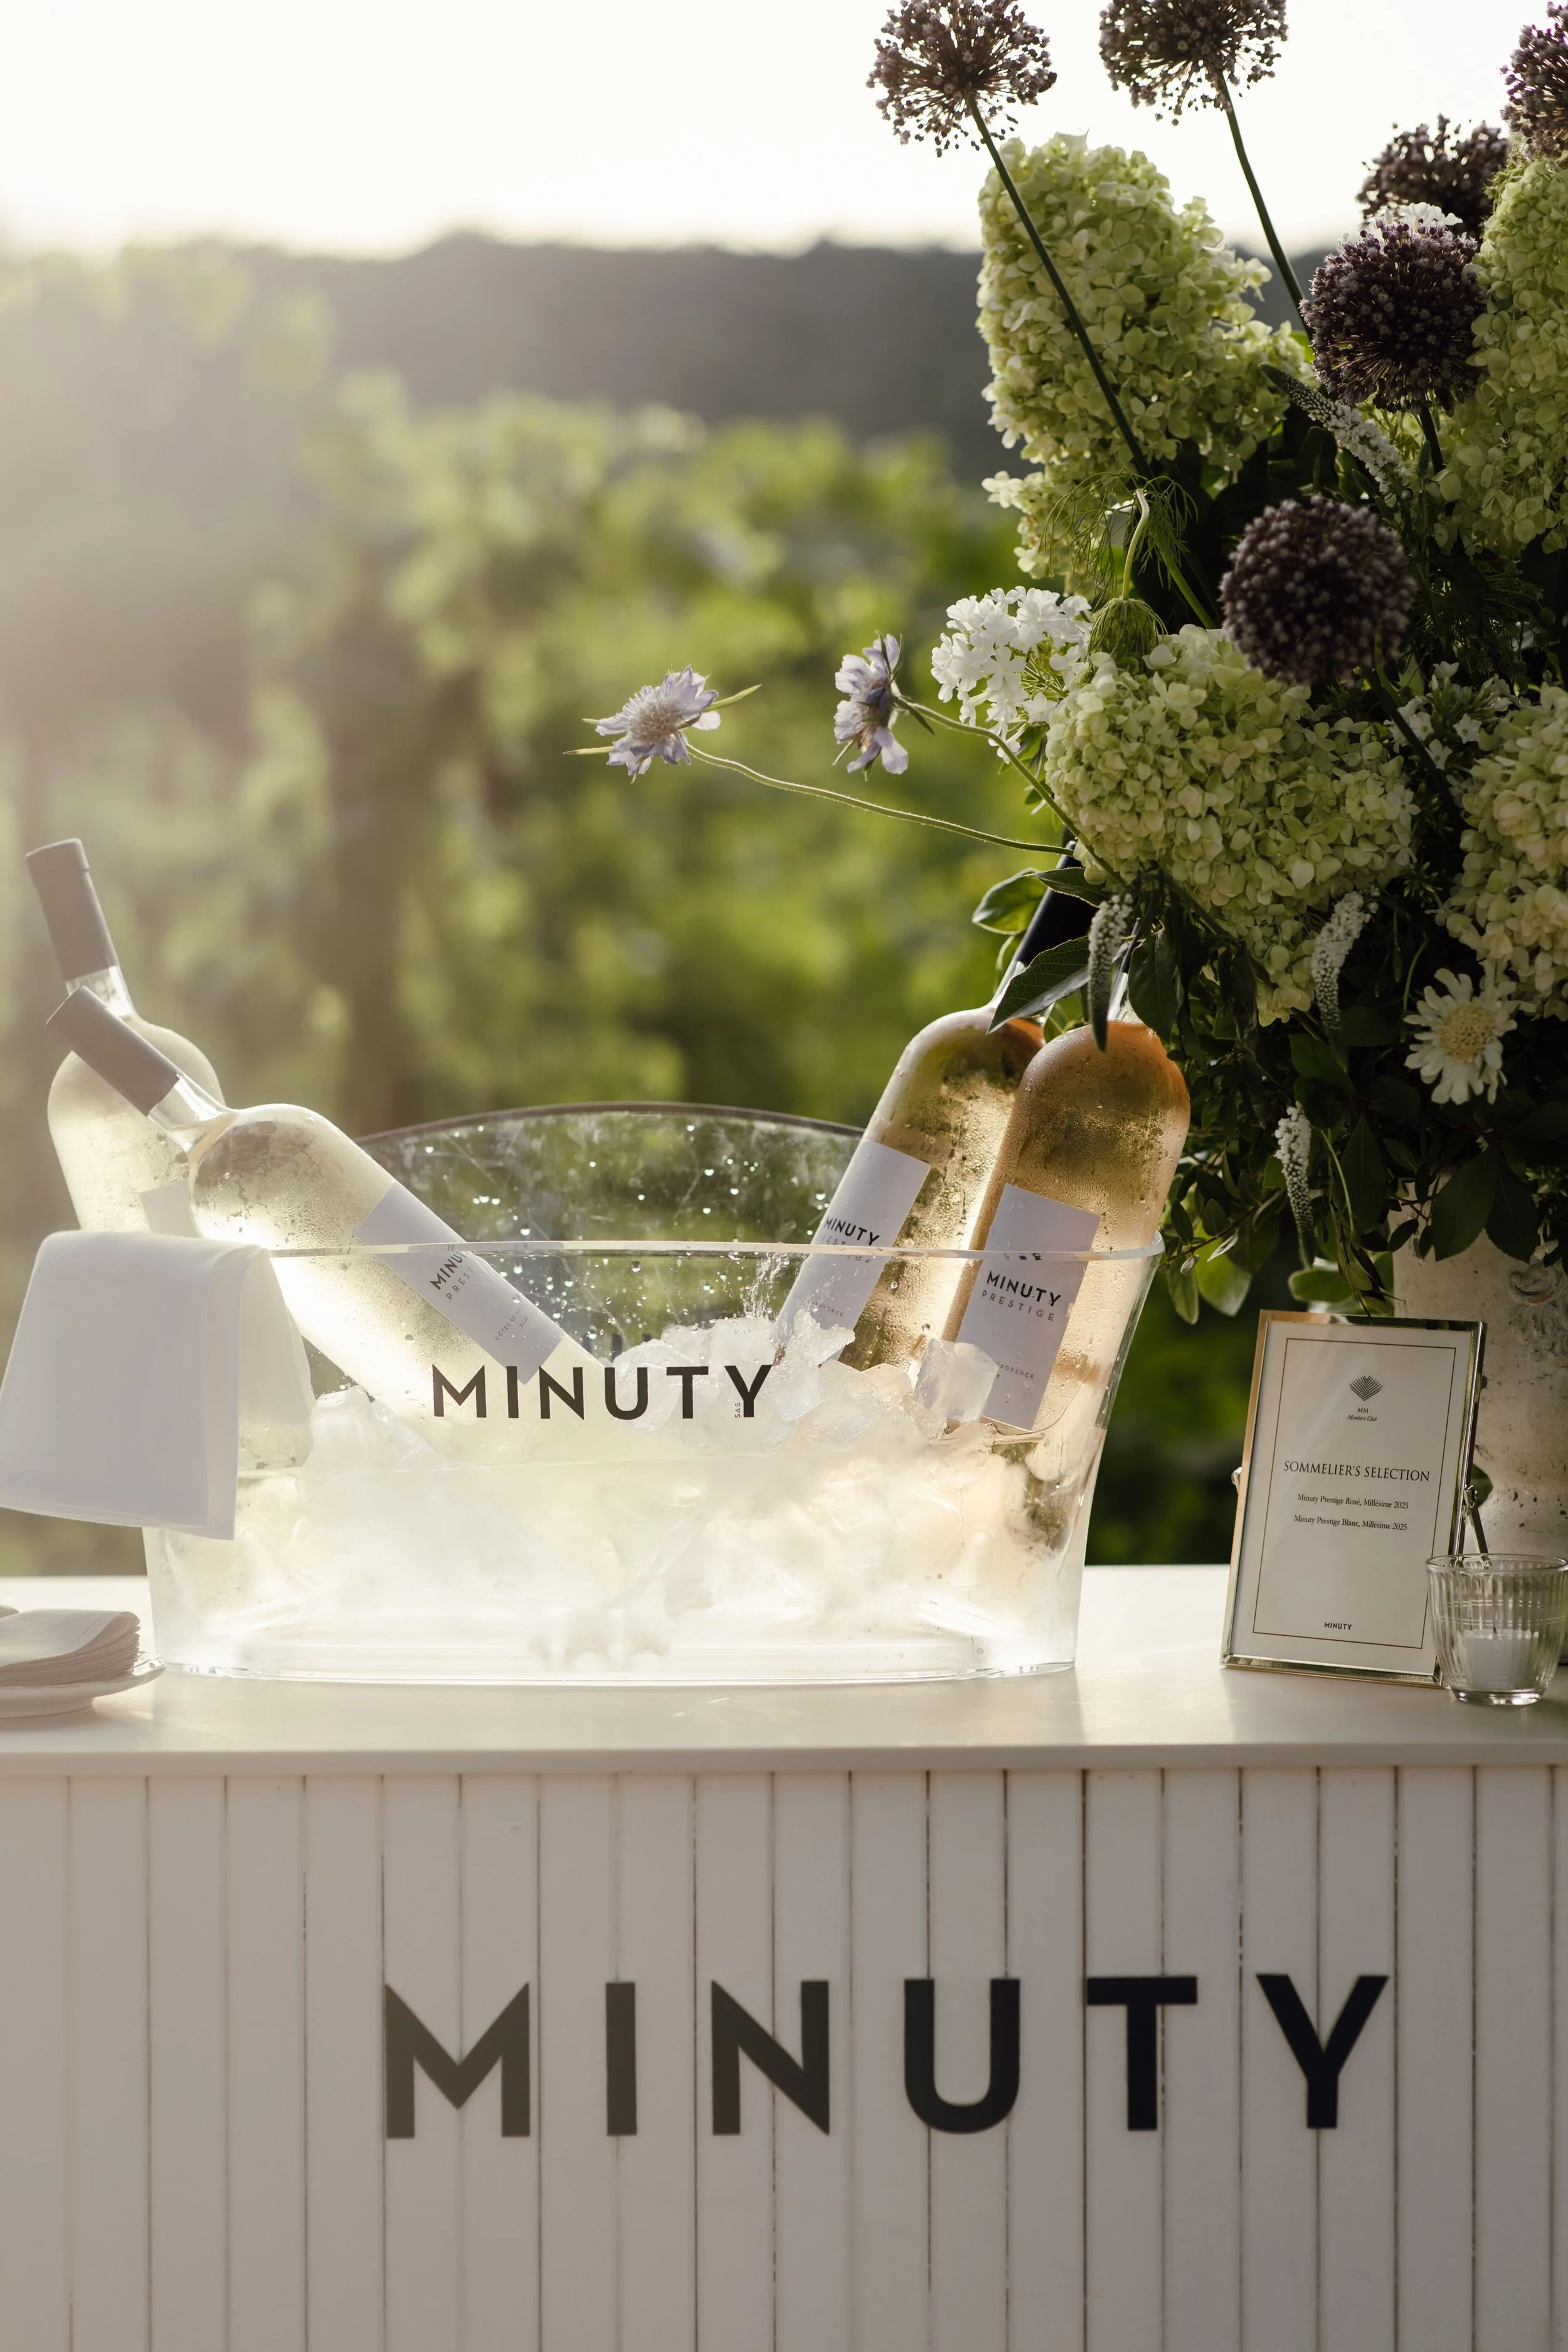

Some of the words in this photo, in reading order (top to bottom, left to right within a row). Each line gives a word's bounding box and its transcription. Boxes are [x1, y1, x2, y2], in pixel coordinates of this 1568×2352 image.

[824, 1218, 880, 1246] MINUTY
[987, 1270, 1062, 1307] MINUTY
[982, 1290, 1055, 1322] PRESTIGE
[432, 1364, 772, 1420] MINUTY
[1283, 1460, 1360, 1476] SOMMELIER'S
[1364, 1466, 1430, 1481] SELECTION
[1297, 1493, 1319, 1504] Minuty
[1320, 1495, 1344, 1505] Prestige
[1345, 1497, 1362, 1507] Rosé,
[1364, 1498, 1392, 1508] Millésime
[1394, 1501, 1409, 1509] 2025
[1294, 1515, 1315, 1525] Minuty
[1317, 1517, 1340, 1527] Prestige
[1342, 1518, 1360, 1528] Blanc,
[1362, 1520, 1391, 1530] Millésime
[1392, 1523, 1407, 1531] 2025
[1324, 1622, 1352, 1630] MINUTY
[385, 1974, 1389, 2139] MINUTY
